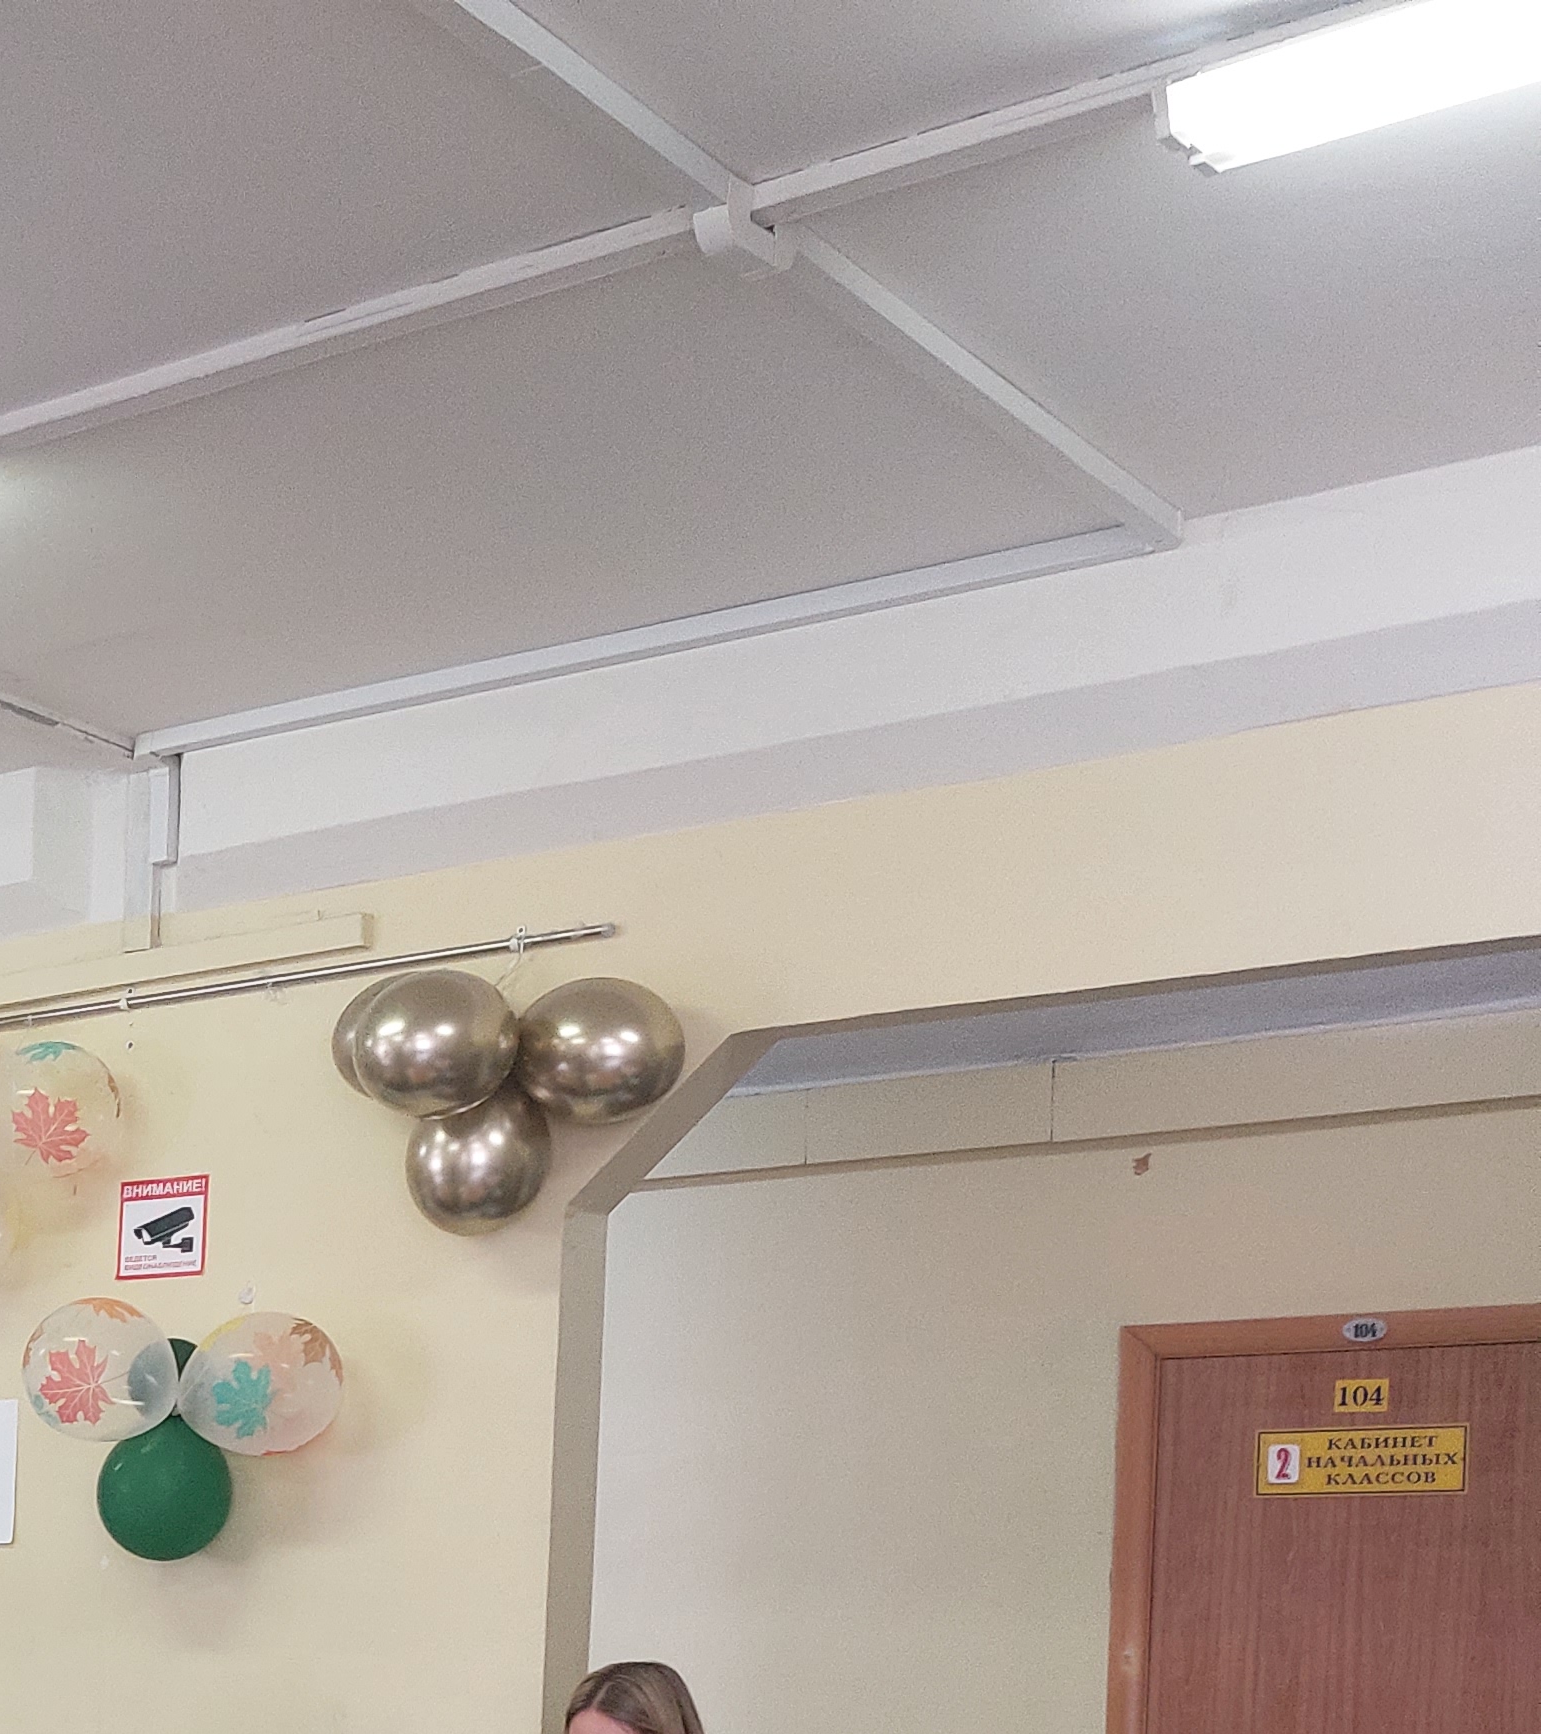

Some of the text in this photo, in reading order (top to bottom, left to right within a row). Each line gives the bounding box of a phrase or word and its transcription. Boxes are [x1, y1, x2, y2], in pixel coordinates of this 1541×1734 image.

[123, 1178, 206, 1198] ВНИМАНИЕ!
[1353, 1323, 1377, 1338] 104
[1338, 1385, 1384, 1407] 104
[1327, 1435, 1439, 1451] КАБИНЕТ
[1274, 1447, 1292, 1480] 2
[1306, 1452, 1458, 1470] НАЧАЛЬНЫХ
[1325, 1470, 1437, 1487] КЛАССОВ
